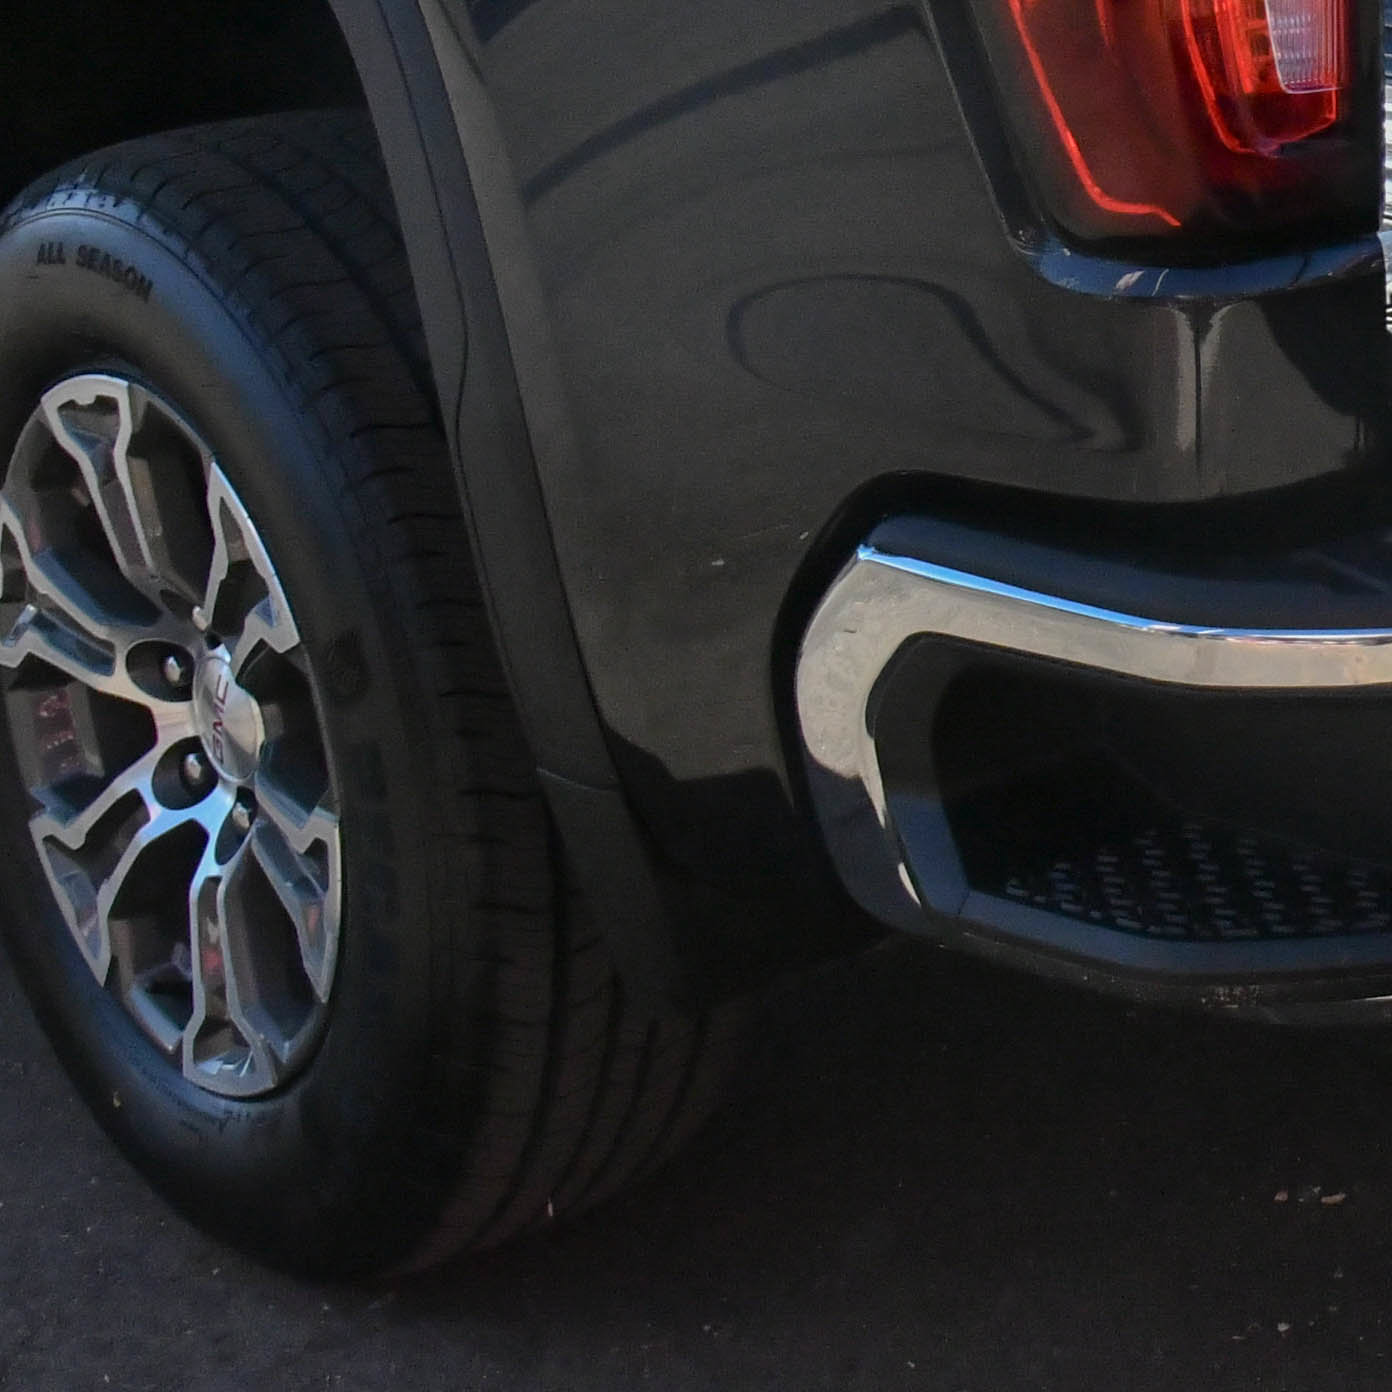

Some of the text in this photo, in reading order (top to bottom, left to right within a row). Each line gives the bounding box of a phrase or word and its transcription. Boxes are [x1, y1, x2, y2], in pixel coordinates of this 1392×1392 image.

[37, 241, 153, 303] ALL SEASON
[212, 674, 229, 765] GMC
